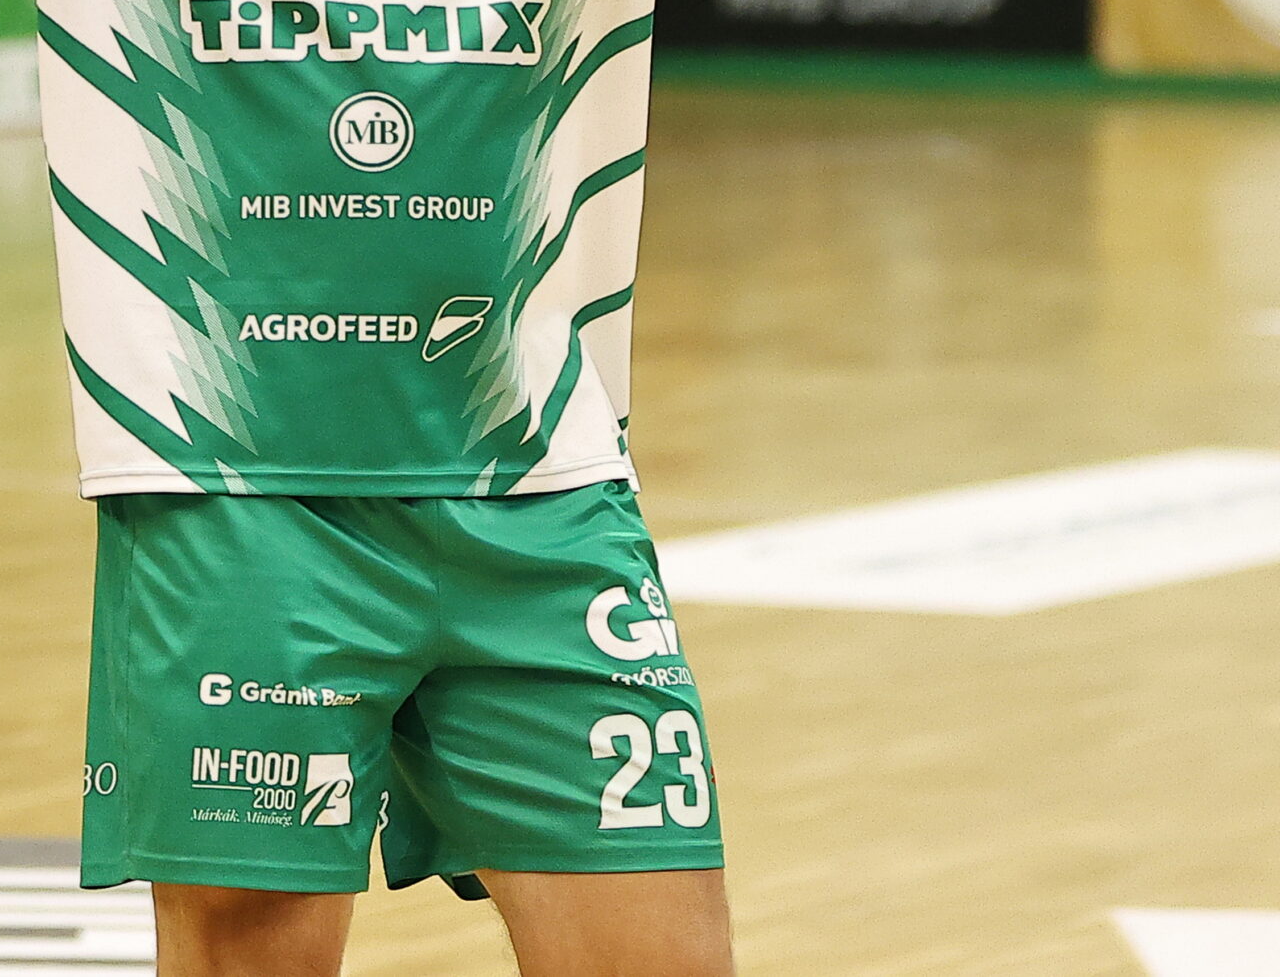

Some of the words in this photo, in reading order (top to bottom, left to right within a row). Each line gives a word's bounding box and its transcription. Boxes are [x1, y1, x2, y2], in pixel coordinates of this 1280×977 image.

[241, 196, 291, 219] MIB
[299, 195, 400, 218] INVEST
[408, 197, 495, 220] GROUP
[239, 315, 418, 342] AGROFEED
[240, 682, 318, 706] Gránit
[192, 747, 300, 786] IN-FOOD
[589, 710, 710, 829] 23
[253, 788, 296, 810] 2000
